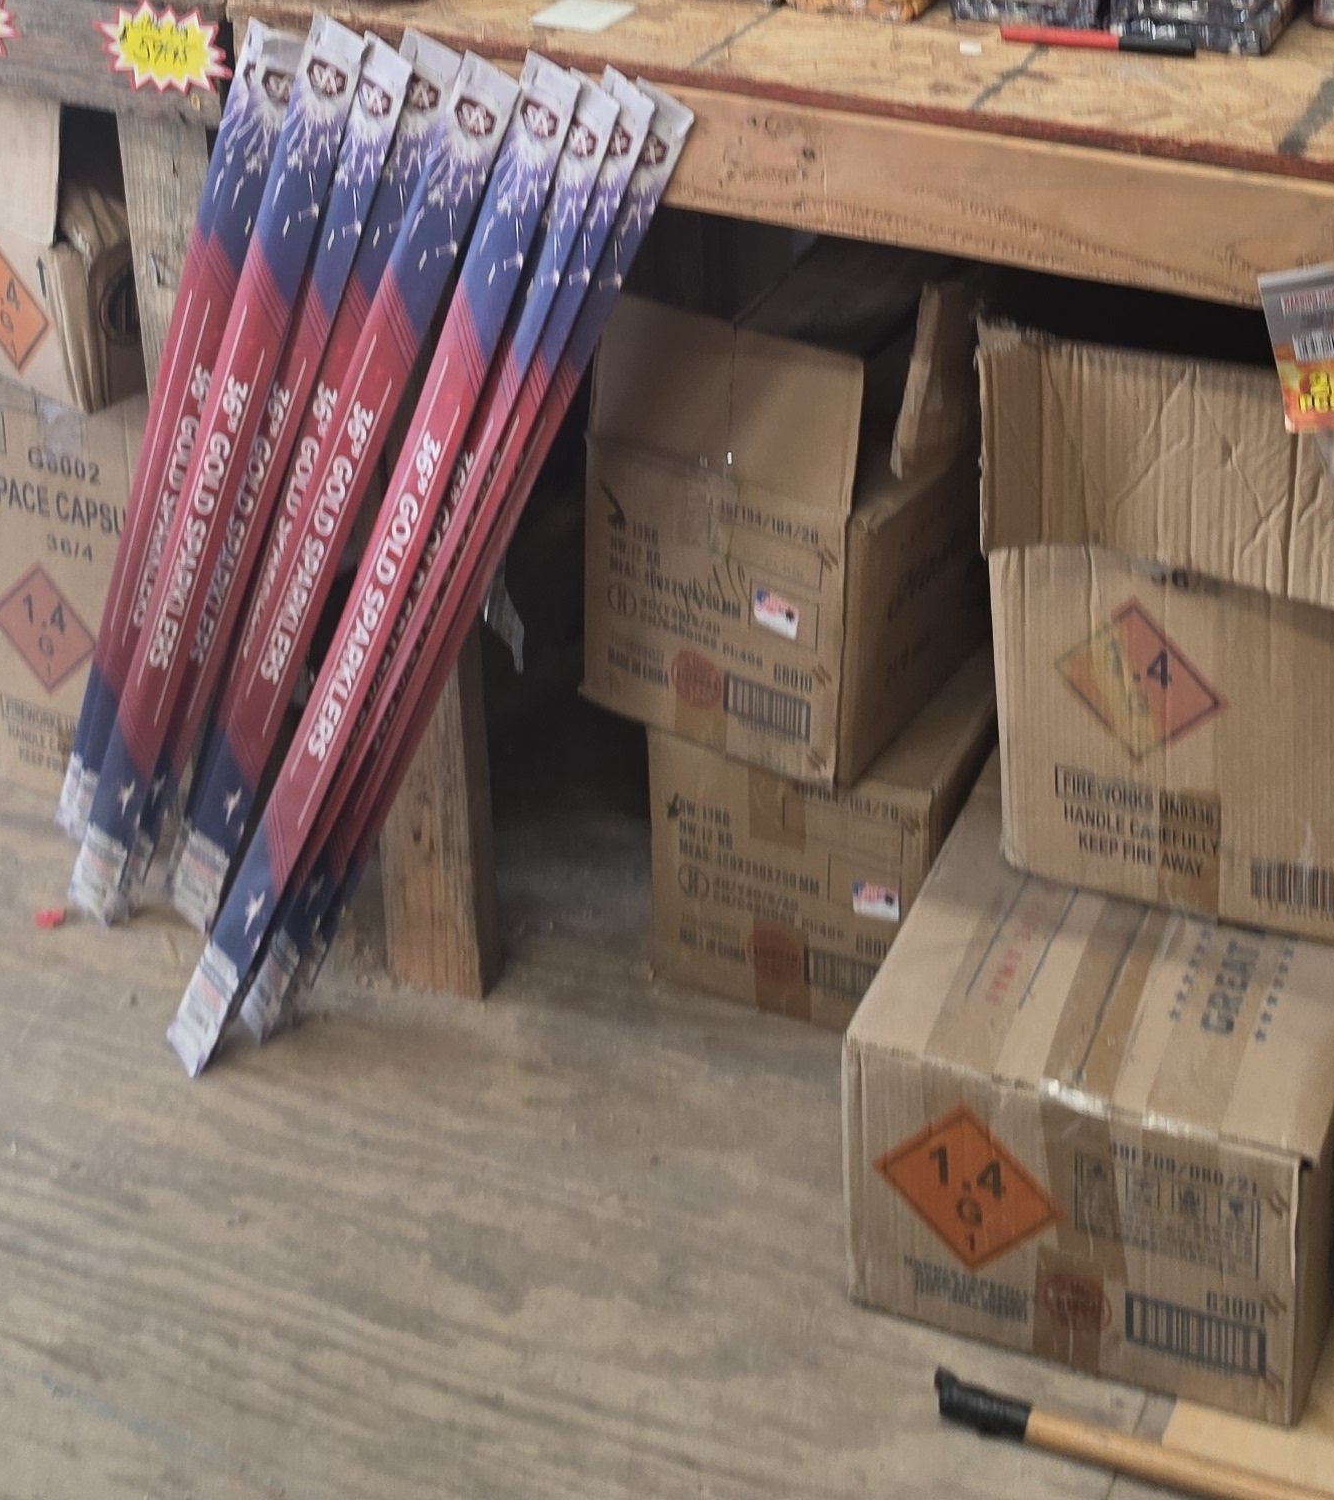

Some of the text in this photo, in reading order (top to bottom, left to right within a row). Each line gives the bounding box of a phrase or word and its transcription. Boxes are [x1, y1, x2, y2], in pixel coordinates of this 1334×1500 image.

[0, 311, 14, 334] G
[194, 431, 231, 517] GOLD
[236, 435, 272, 518] GOLD
[285, 436, 321, 520] GOLD
[313, 455, 354, 538] GOLD
[375, 491, 420, 587] GOLD
[22, 593, 67, 635] 1.4
[149, 518, 208, 671] SPARKLERS
[190, 517, 246, 664] SPARKLERS
[260, 535, 325, 685] SPARKLERS
[38, 633, 55, 659] G
[307, 585, 385, 761] SPARKLERS
[1063, 769, 1154, 814] FIREWORKS
[1063, 802, 1219, 857] HANDLE CAREFULLY
[1078, 830, 1205, 879] KEEP FIRE AWAY
[1200, 940, 1263, 1037] GREAT
[929, 1145, 1008, 1200] 1.4
[954, 1197, 984, 1230] G
